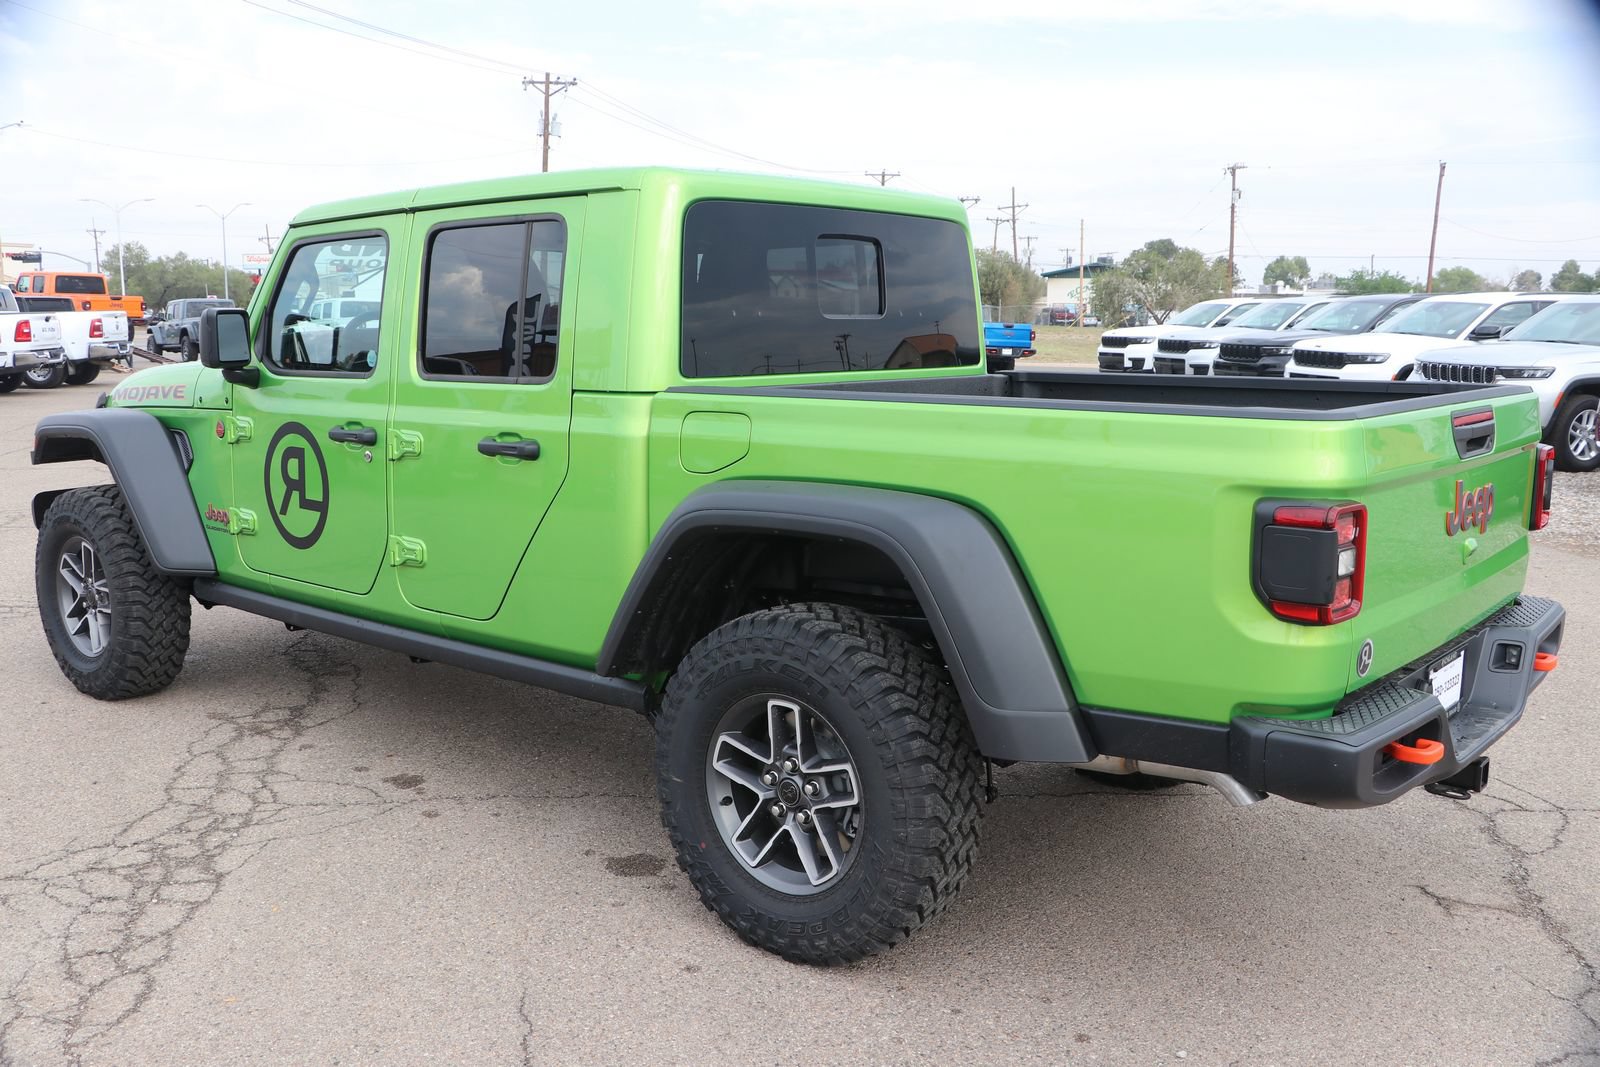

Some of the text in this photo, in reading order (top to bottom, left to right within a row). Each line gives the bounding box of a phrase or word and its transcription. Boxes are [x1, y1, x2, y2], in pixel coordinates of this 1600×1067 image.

[112, 384, 187, 402] MOJAVE
[205, 503, 230, 528] Jeep
[1446, 480, 1494, 537] Jeep
[695, 656, 830, 702] FALKEN
